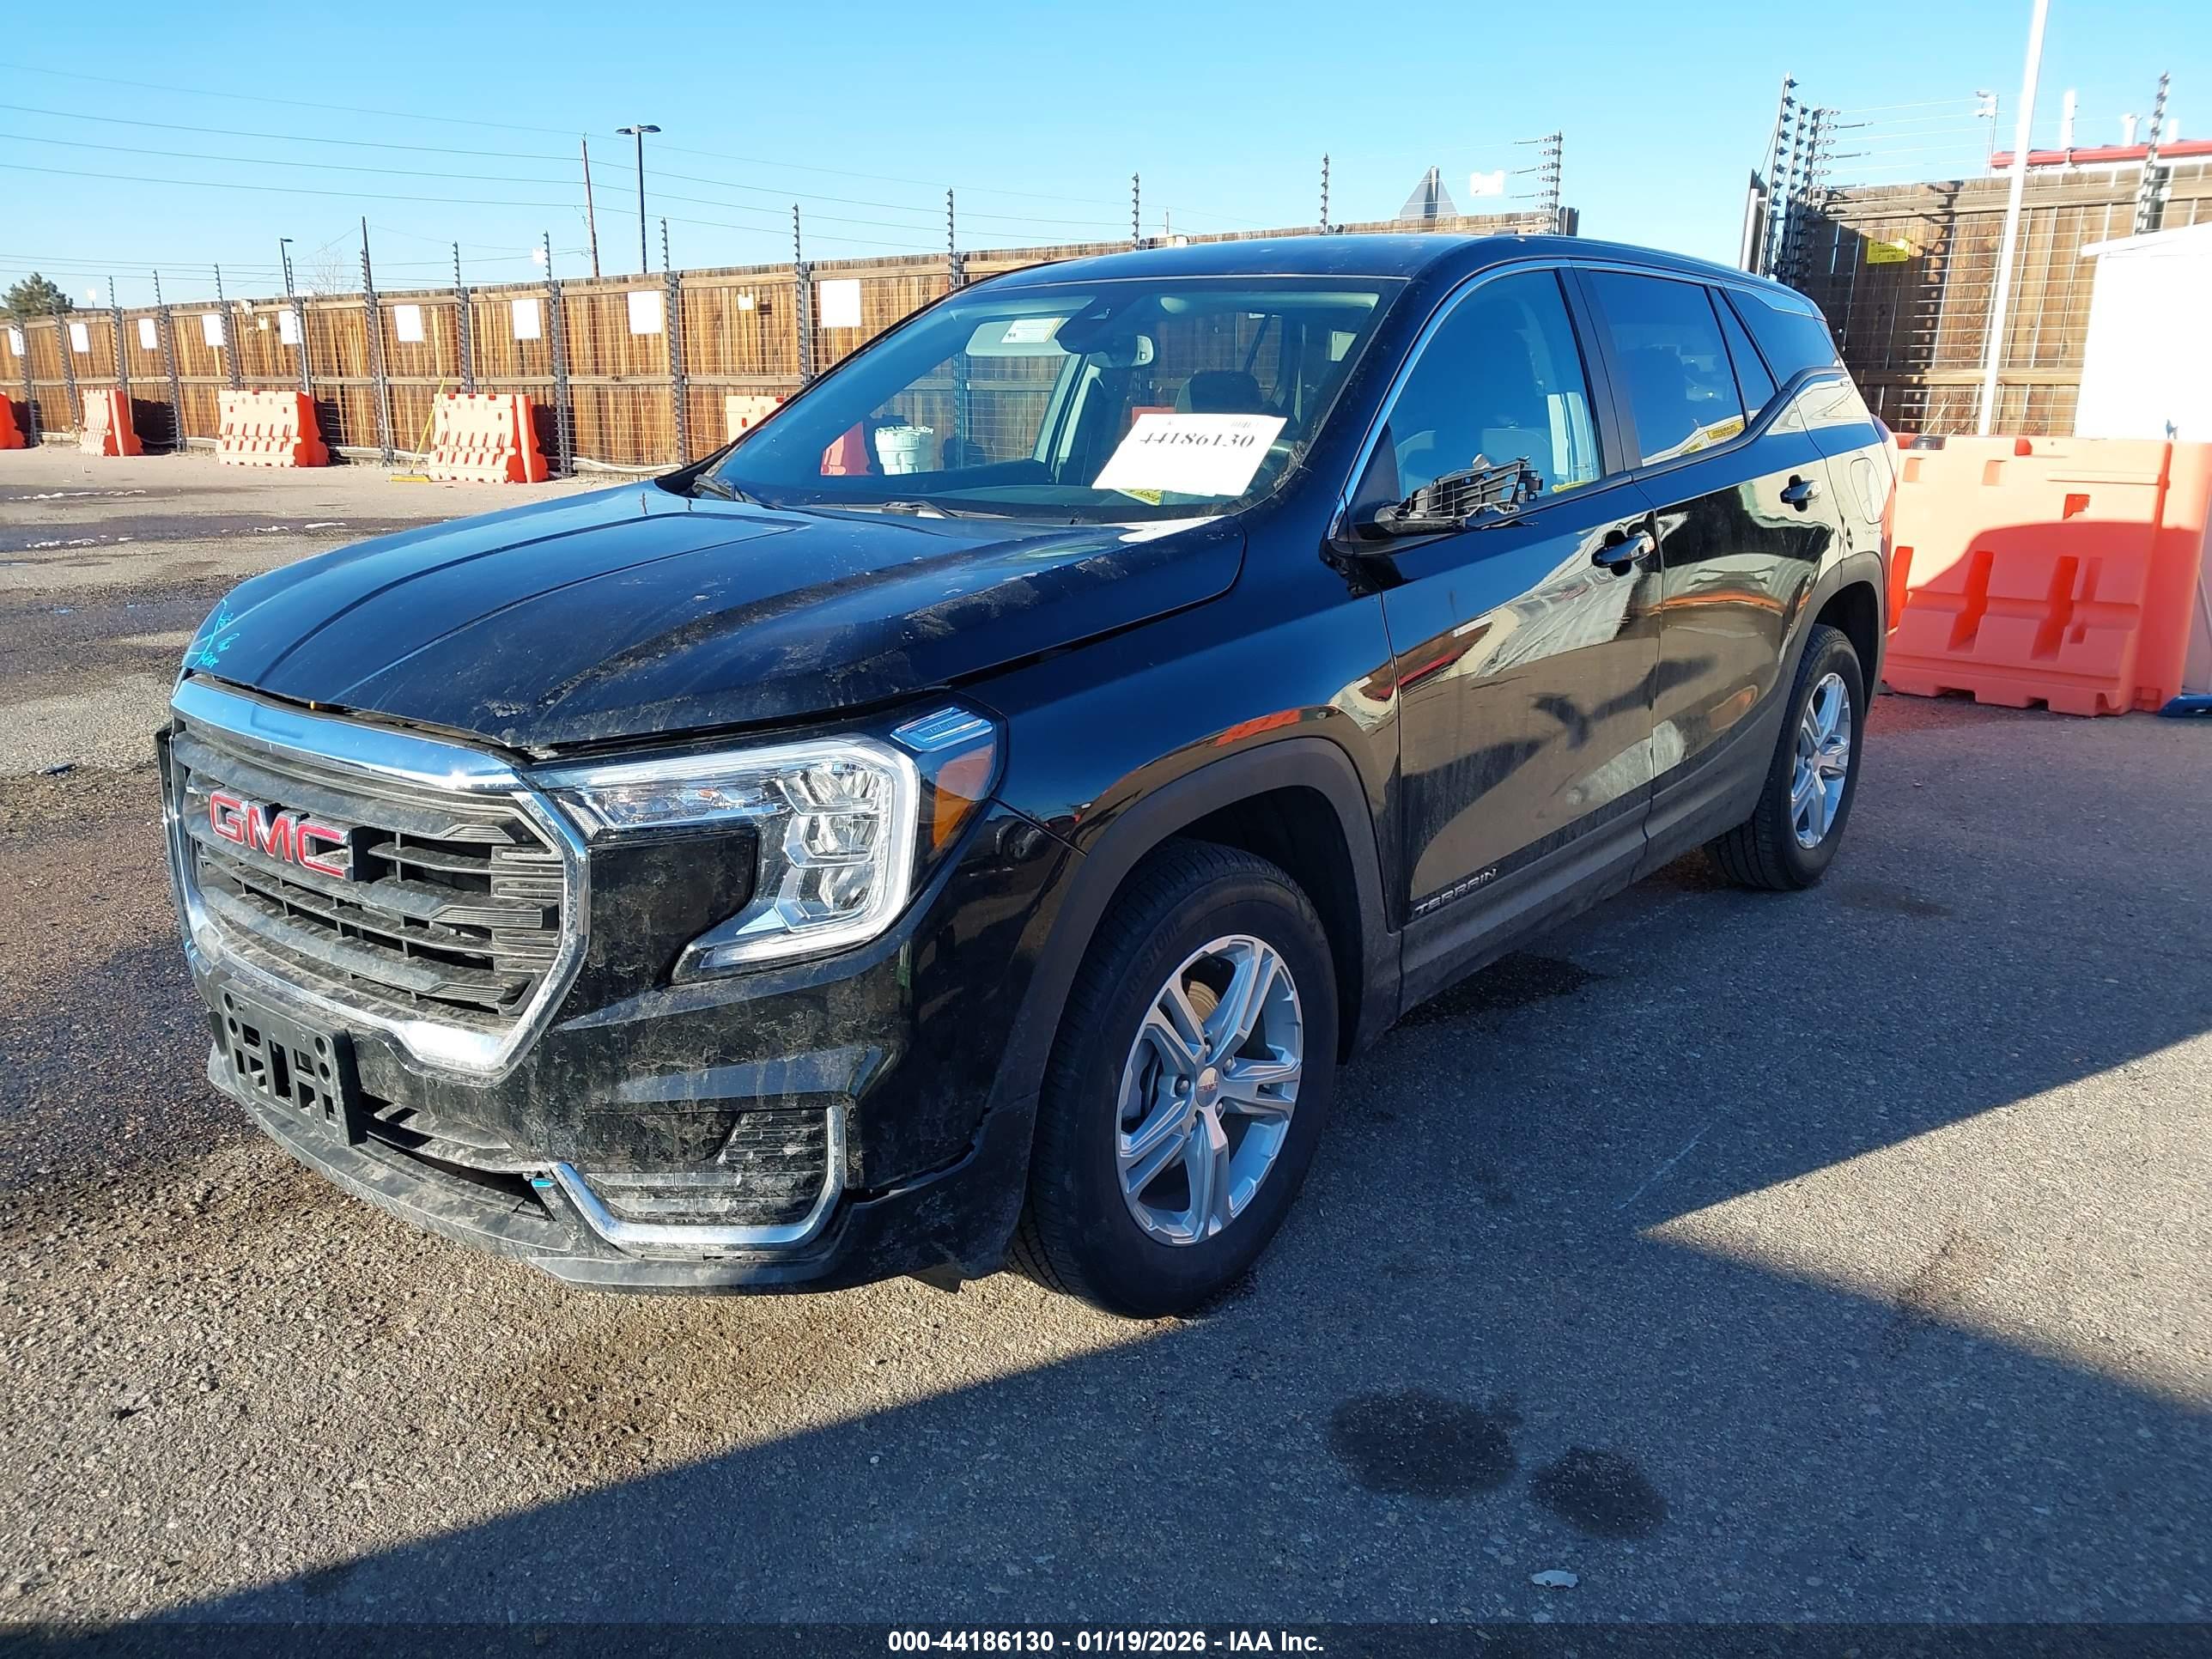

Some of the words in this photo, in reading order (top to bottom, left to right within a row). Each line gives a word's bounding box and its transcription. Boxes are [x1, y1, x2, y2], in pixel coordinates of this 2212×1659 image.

[1139, 431, 1255, 448] 44186130
[210, 792, 349, 879] GMC
[1413, 867, 1497, 915] TERRAIN
